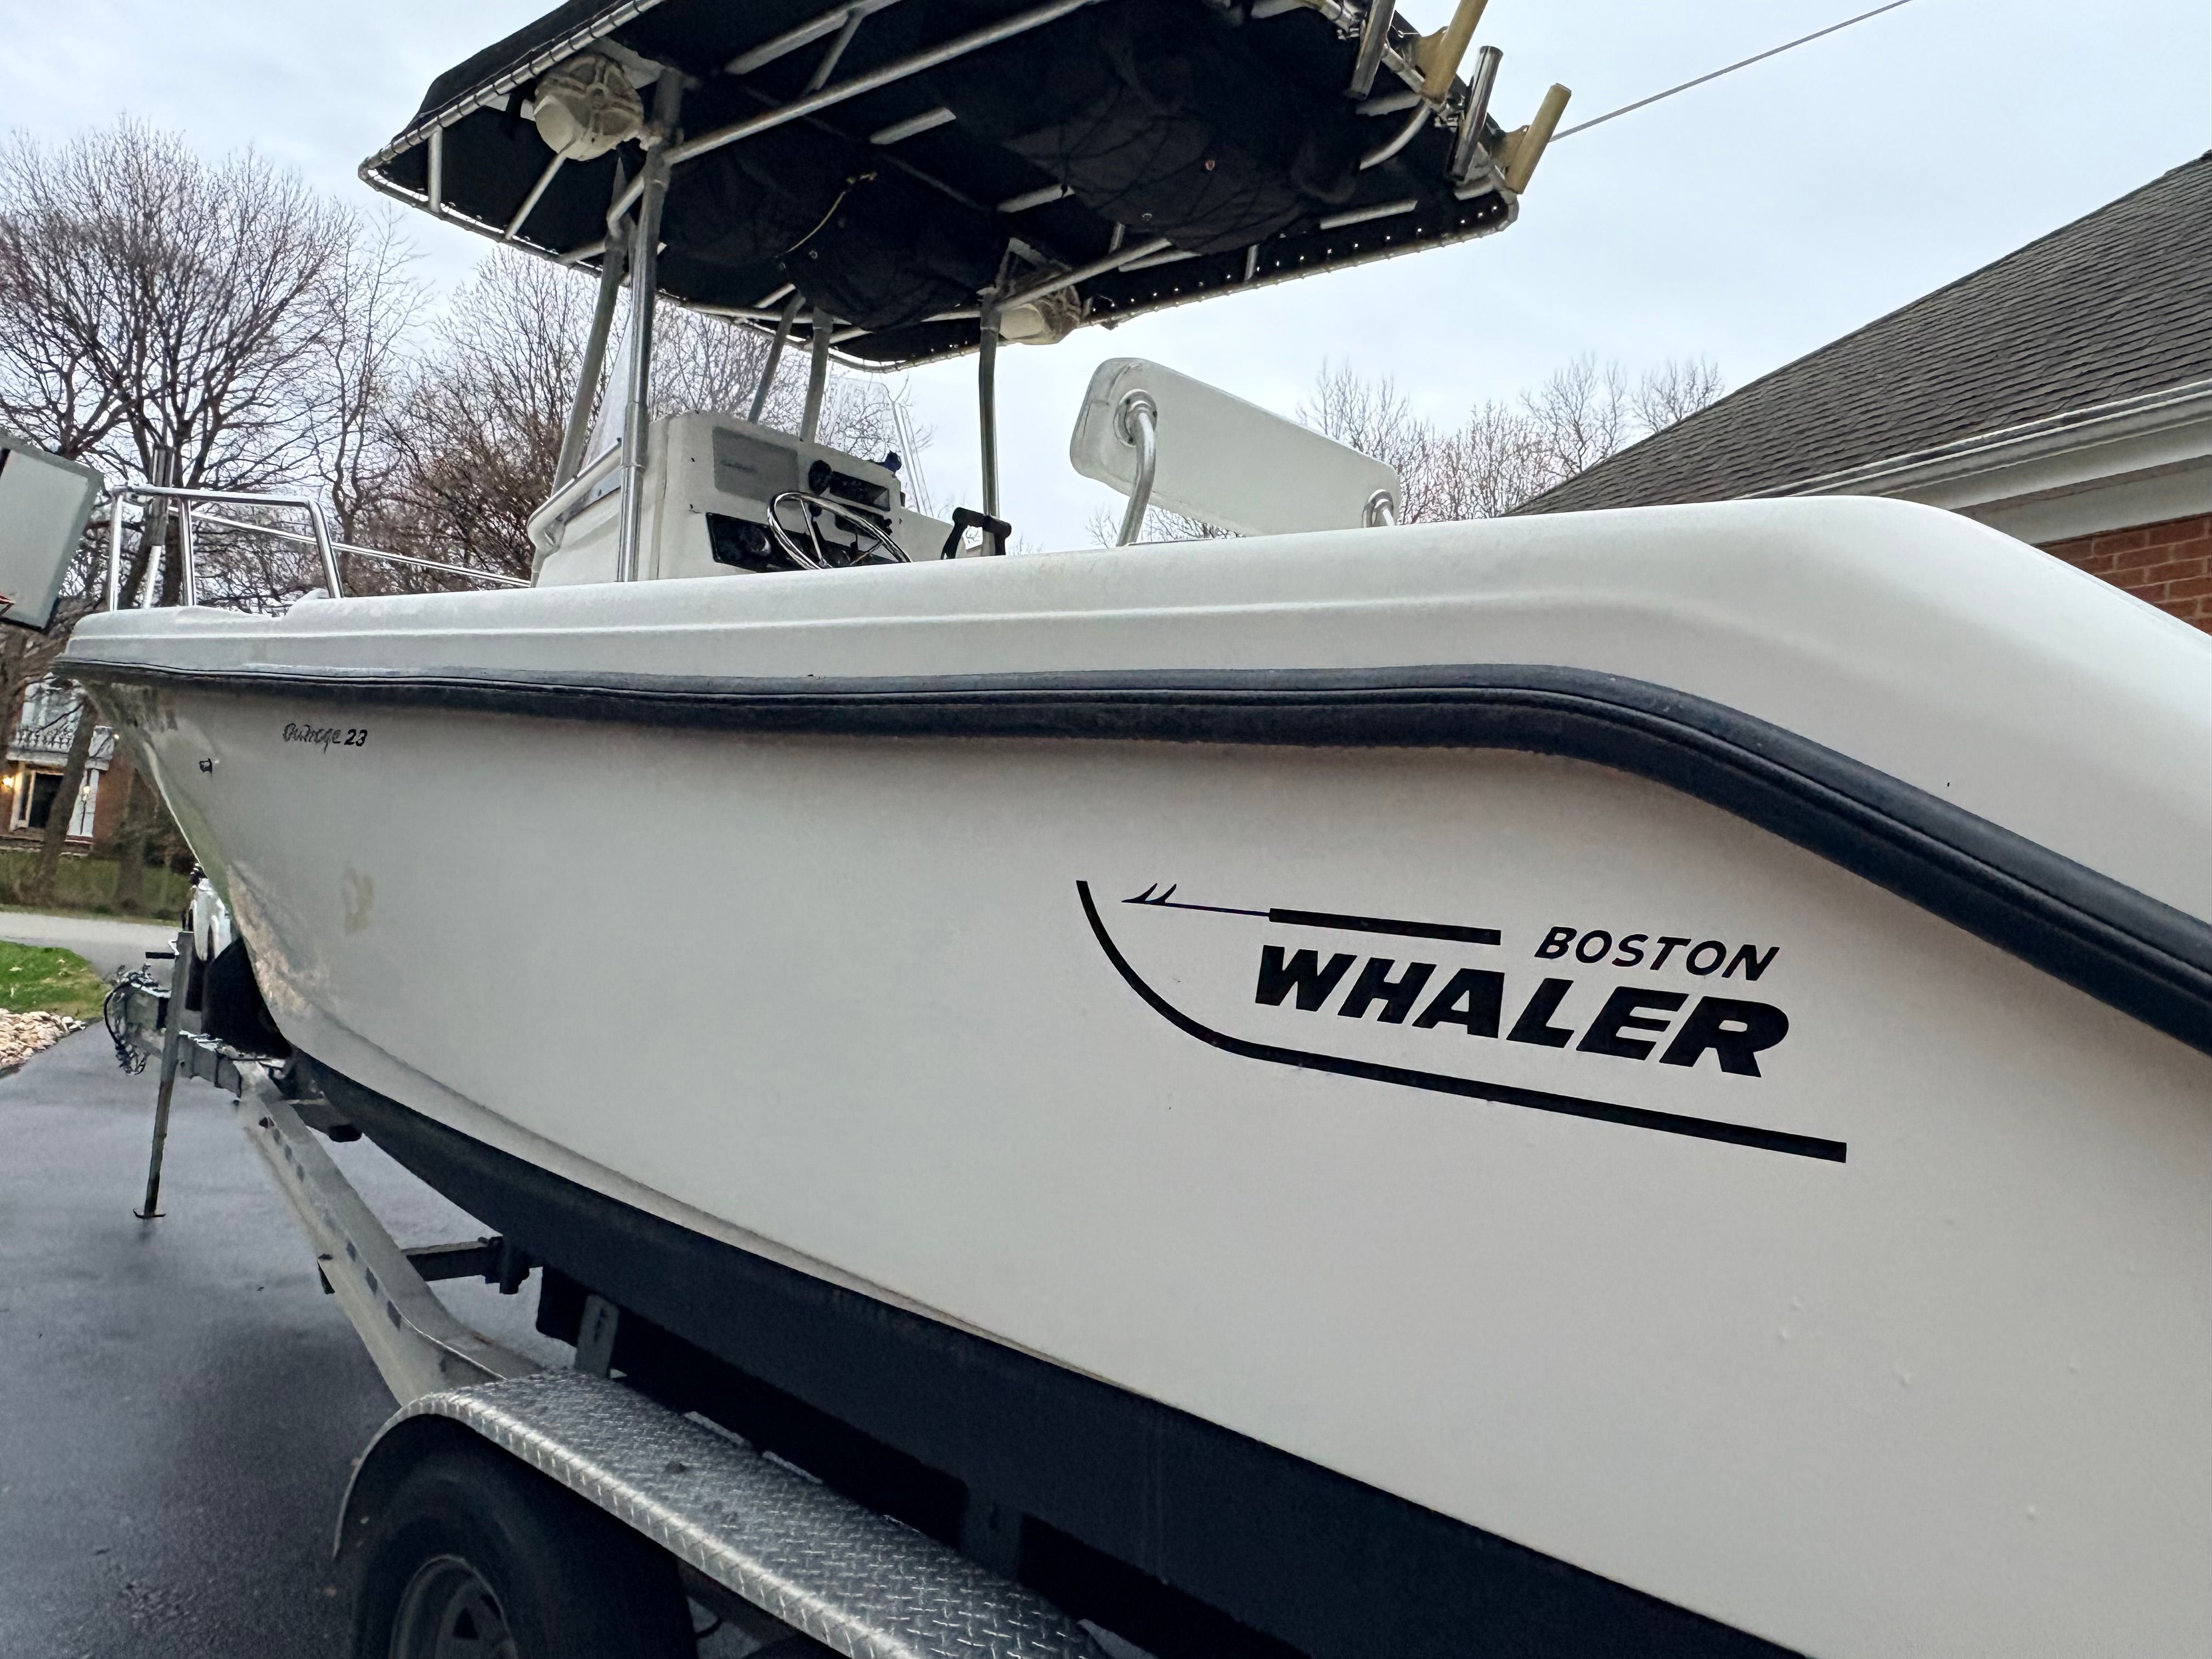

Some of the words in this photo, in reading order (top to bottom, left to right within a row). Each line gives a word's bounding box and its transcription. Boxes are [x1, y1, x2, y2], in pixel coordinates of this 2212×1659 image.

[344, 729, 368, 747] 23
[1534, 926, 1780, 981] BOSTON
[1255, 945, 1789, 1078] WHALER
